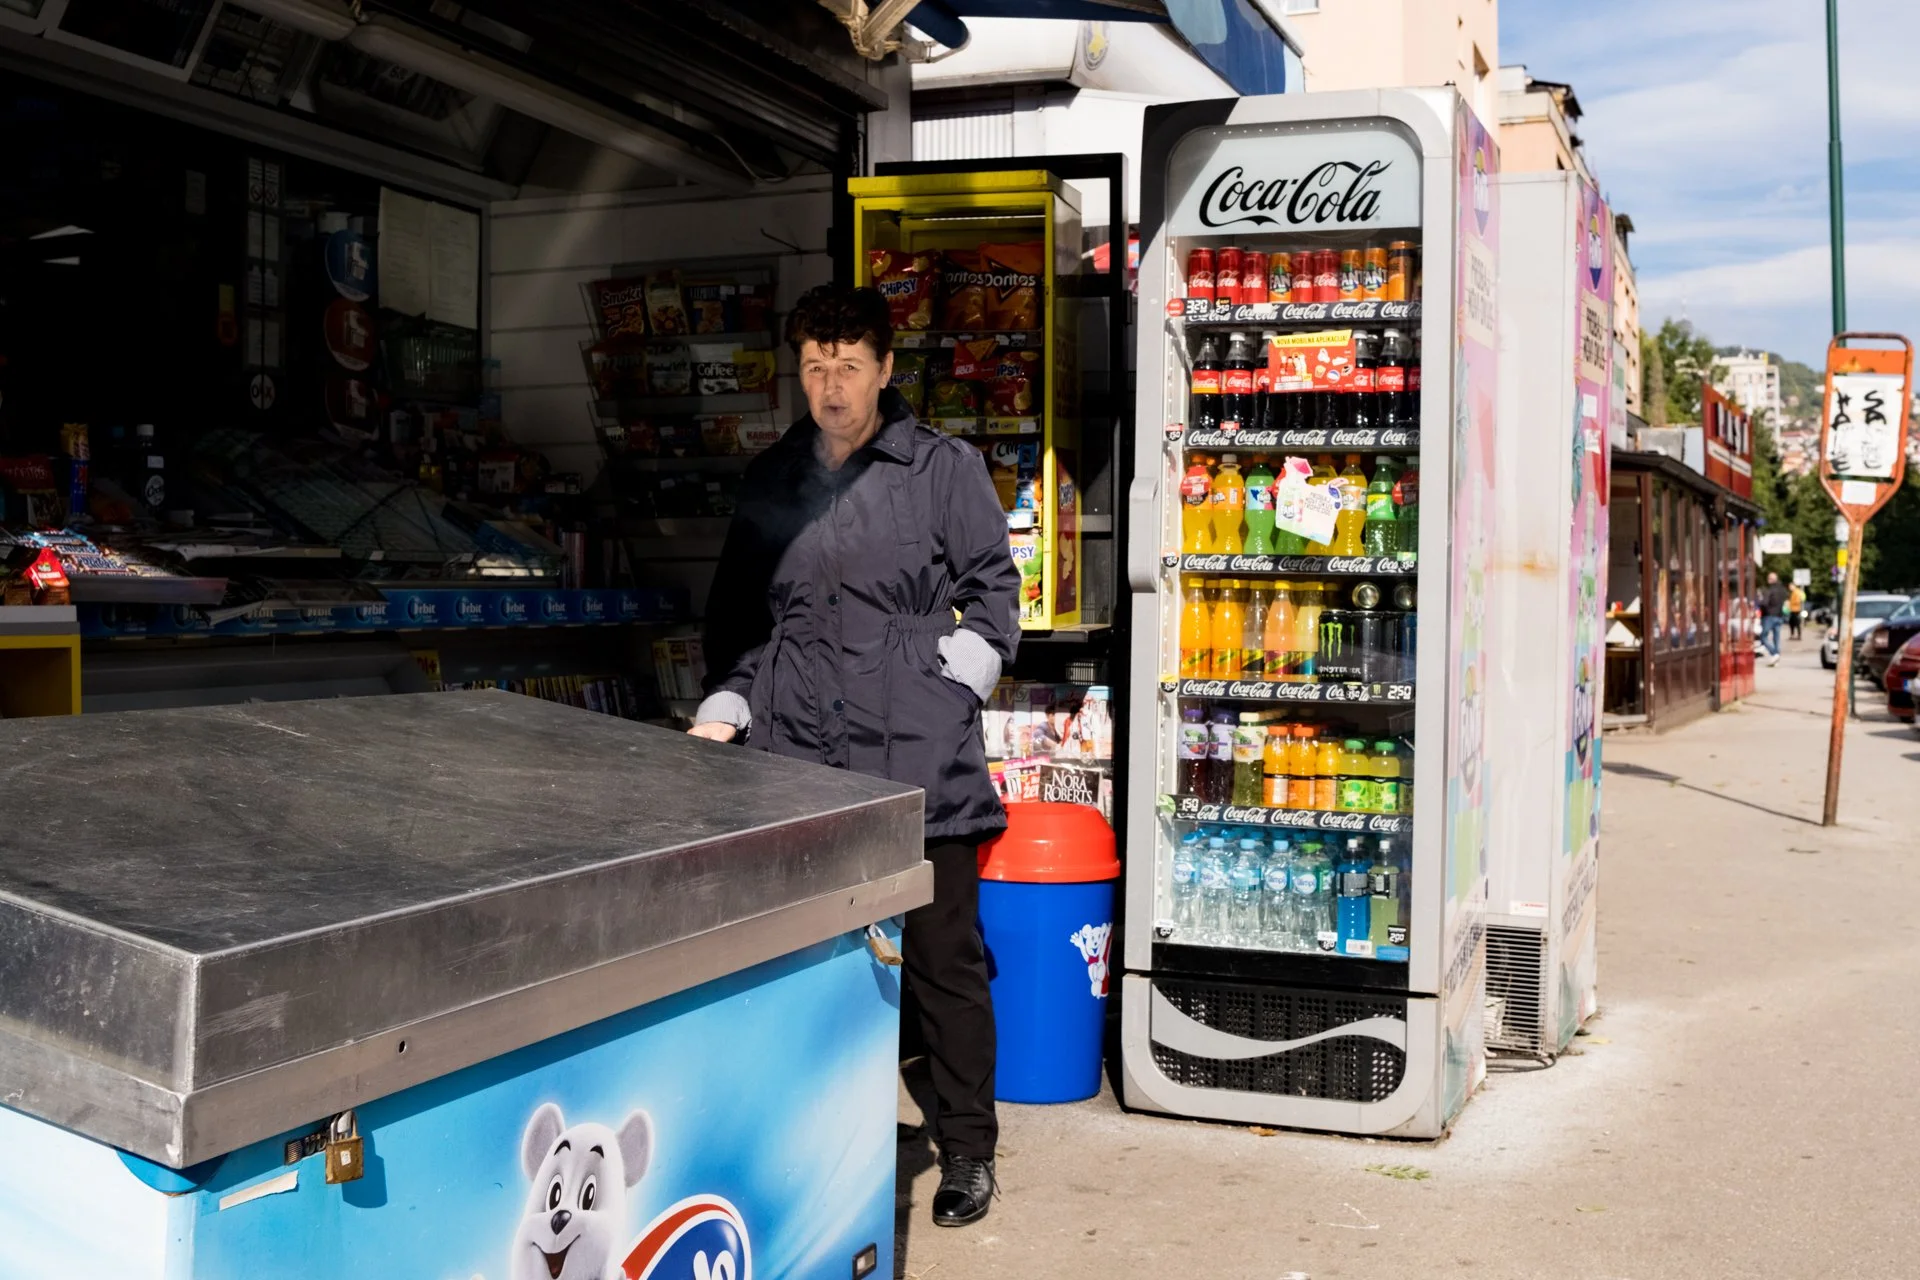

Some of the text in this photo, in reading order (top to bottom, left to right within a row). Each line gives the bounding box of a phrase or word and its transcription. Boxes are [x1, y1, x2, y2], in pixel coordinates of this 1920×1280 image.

[1199, 160, 1393, 227] Coca-Cola
[1052, 770, 1087, 792] NORA
[1044, 783, 1093, 804] ROBERTS
